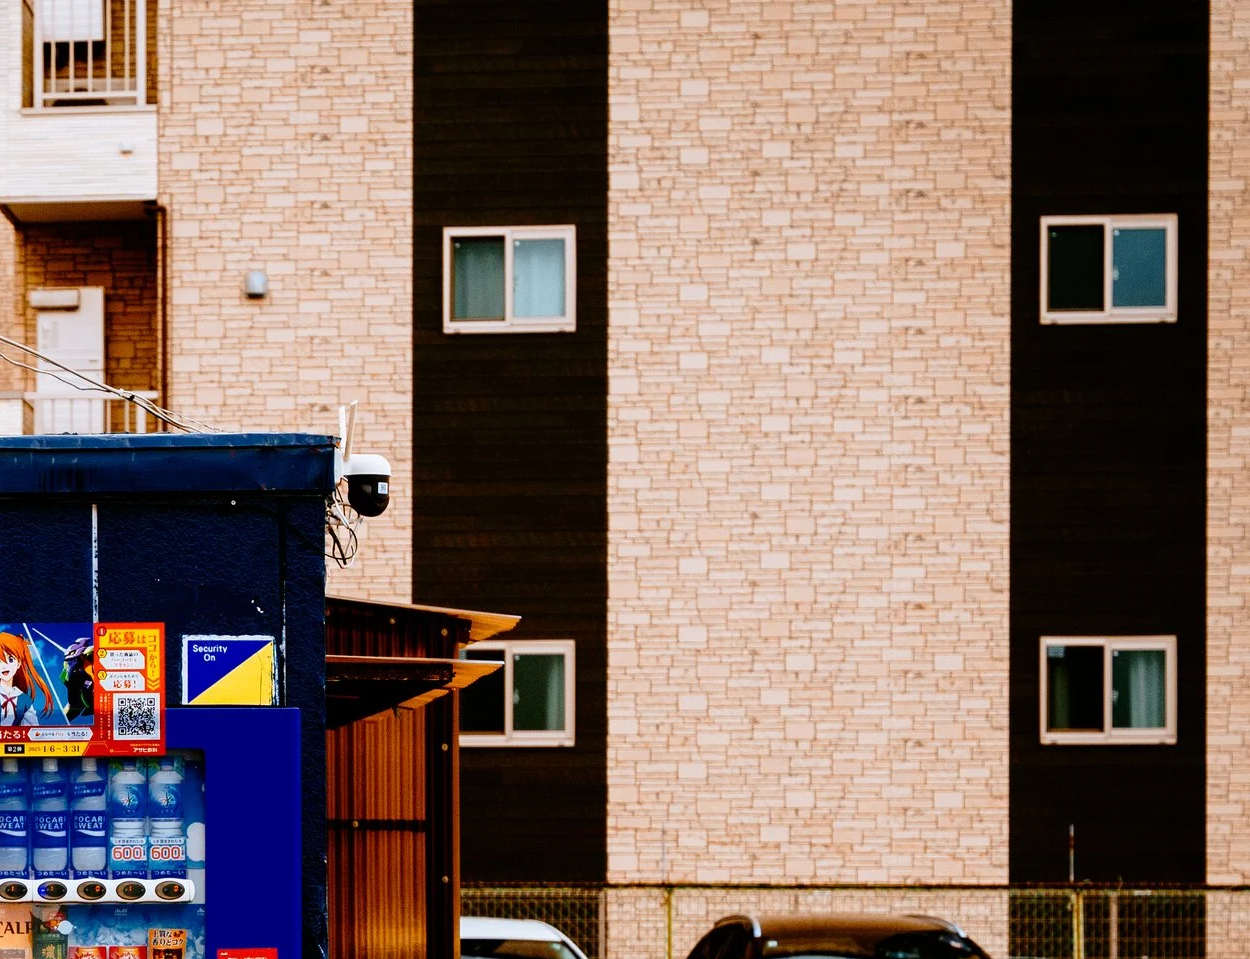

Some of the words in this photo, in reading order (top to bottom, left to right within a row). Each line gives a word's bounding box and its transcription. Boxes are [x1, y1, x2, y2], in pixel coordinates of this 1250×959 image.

[192, 644, 228, 654] Security
[203, 653, 216, 662] On
[113, 847, 142, 859] 600
[151, 847, 181, 859] 600
